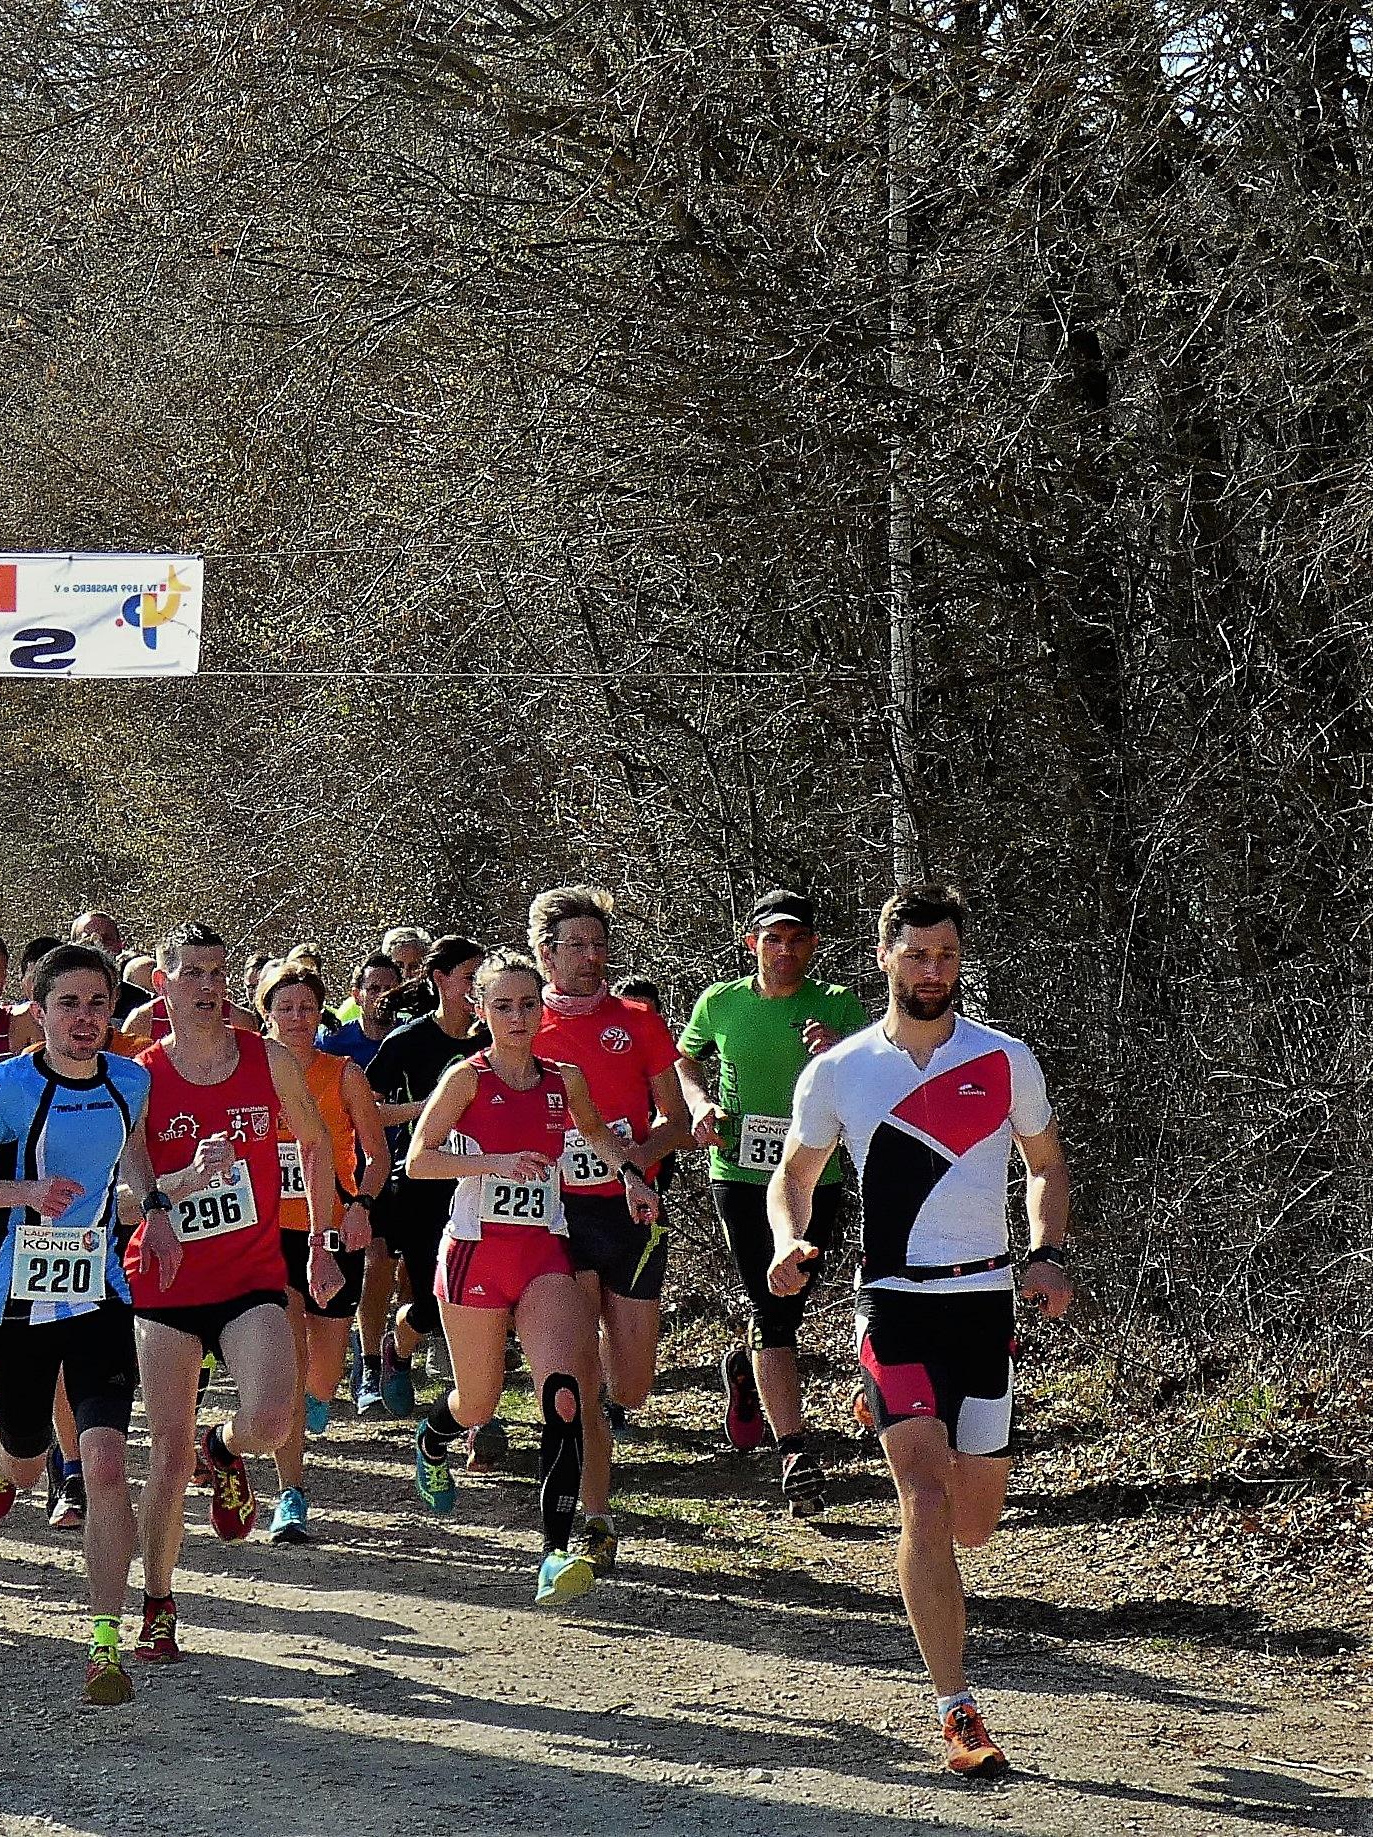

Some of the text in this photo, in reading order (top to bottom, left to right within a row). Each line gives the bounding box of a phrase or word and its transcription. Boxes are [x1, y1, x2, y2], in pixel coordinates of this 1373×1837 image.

[179, 1193, 241, 1233] 296
[493, 1185, 544, 1218] 223
[23, 1238, 80, 1251] KÖNIG
[27, 1258, 91, 1293] 220
